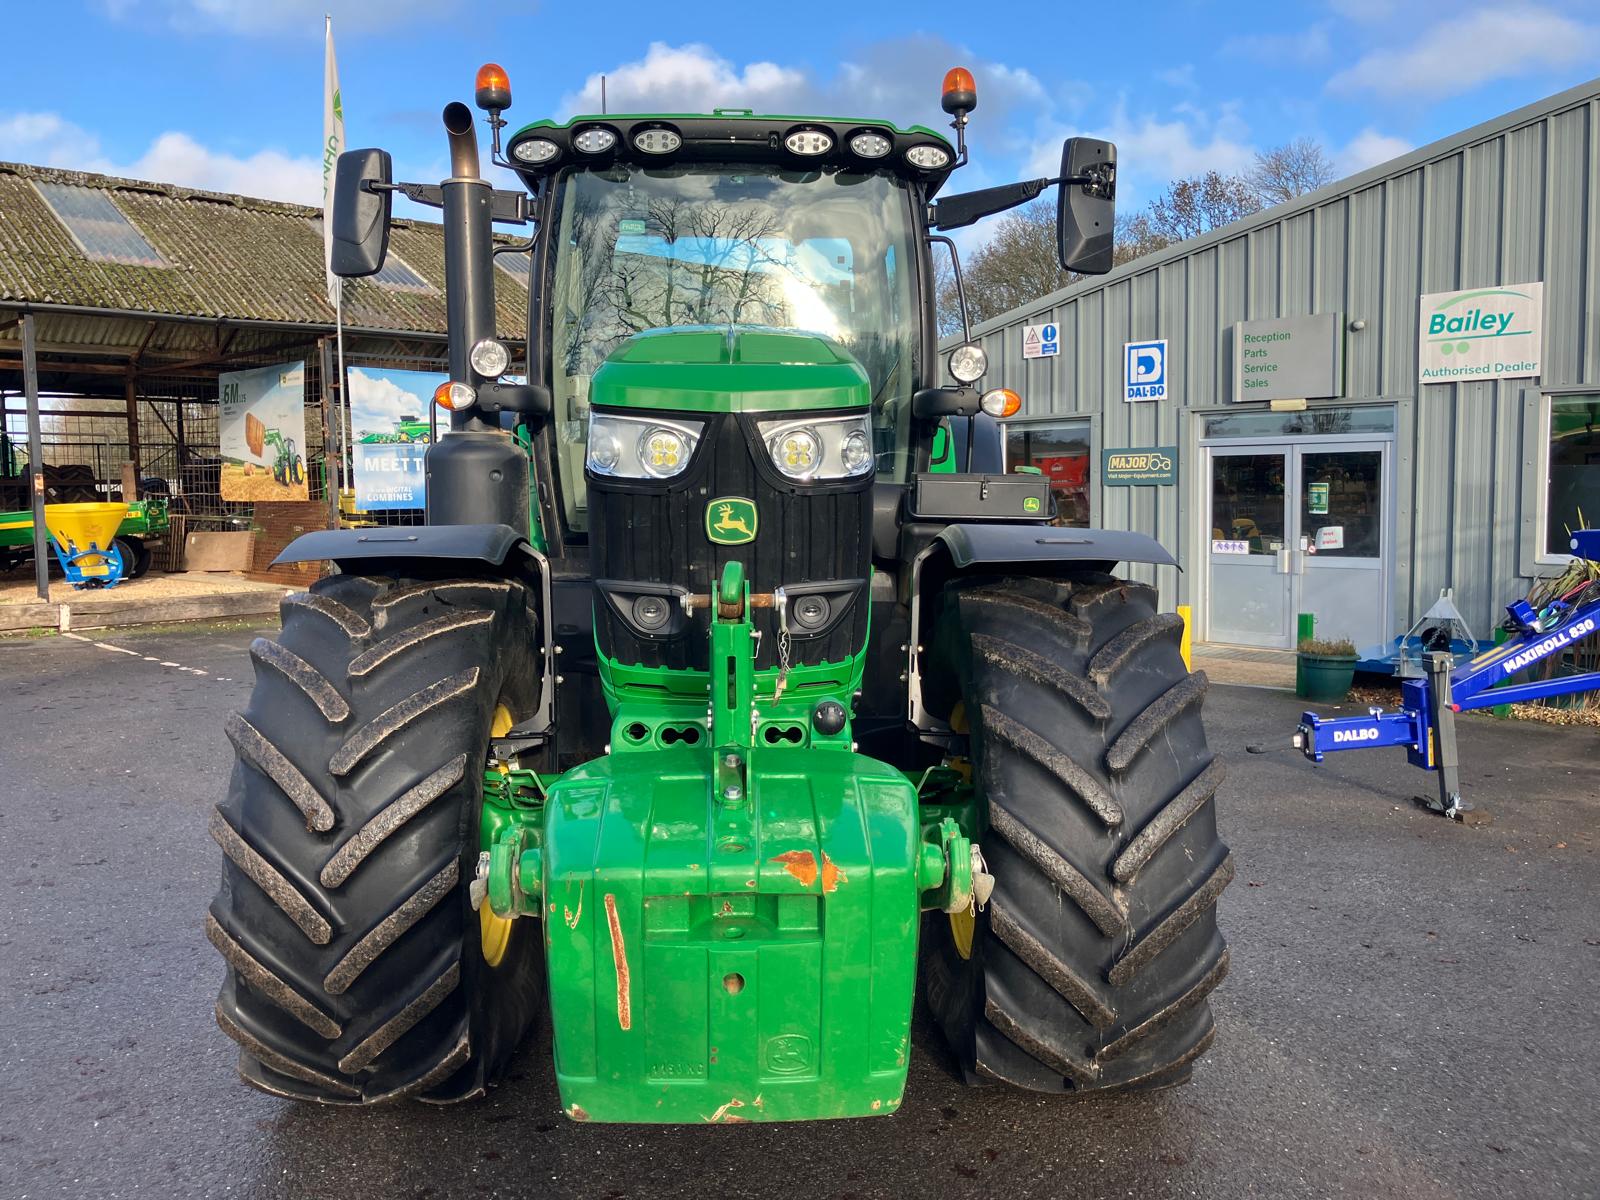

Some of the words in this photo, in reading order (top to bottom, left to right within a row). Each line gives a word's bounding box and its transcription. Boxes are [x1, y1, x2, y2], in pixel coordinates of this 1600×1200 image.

[1428, 308, 1515, 336] Bailey
[1244, 332, 1291, 344] Reception
[1244, 348, 1268, 358] Parts
[1244, 364, 1278, 374] Service
[1422, 364, 1490, 378] Authorised
[1495, 361, 1537, 374] Dealer
[1244, 379, 1269, 389] Sales
[224, 383, 239, 404] 6M
[365, 457, 409, 472] MEET
[413, 457, 423, 472] T
[1111, 456, 1147, 469] MAJOR
[367, 493, 414, 502] COMBINES
[1503, 633, 1570, 673] MAXIROLL
[1568, 619, 1595, 638] 830
[1333, 728, 1379, 742] DALBO
